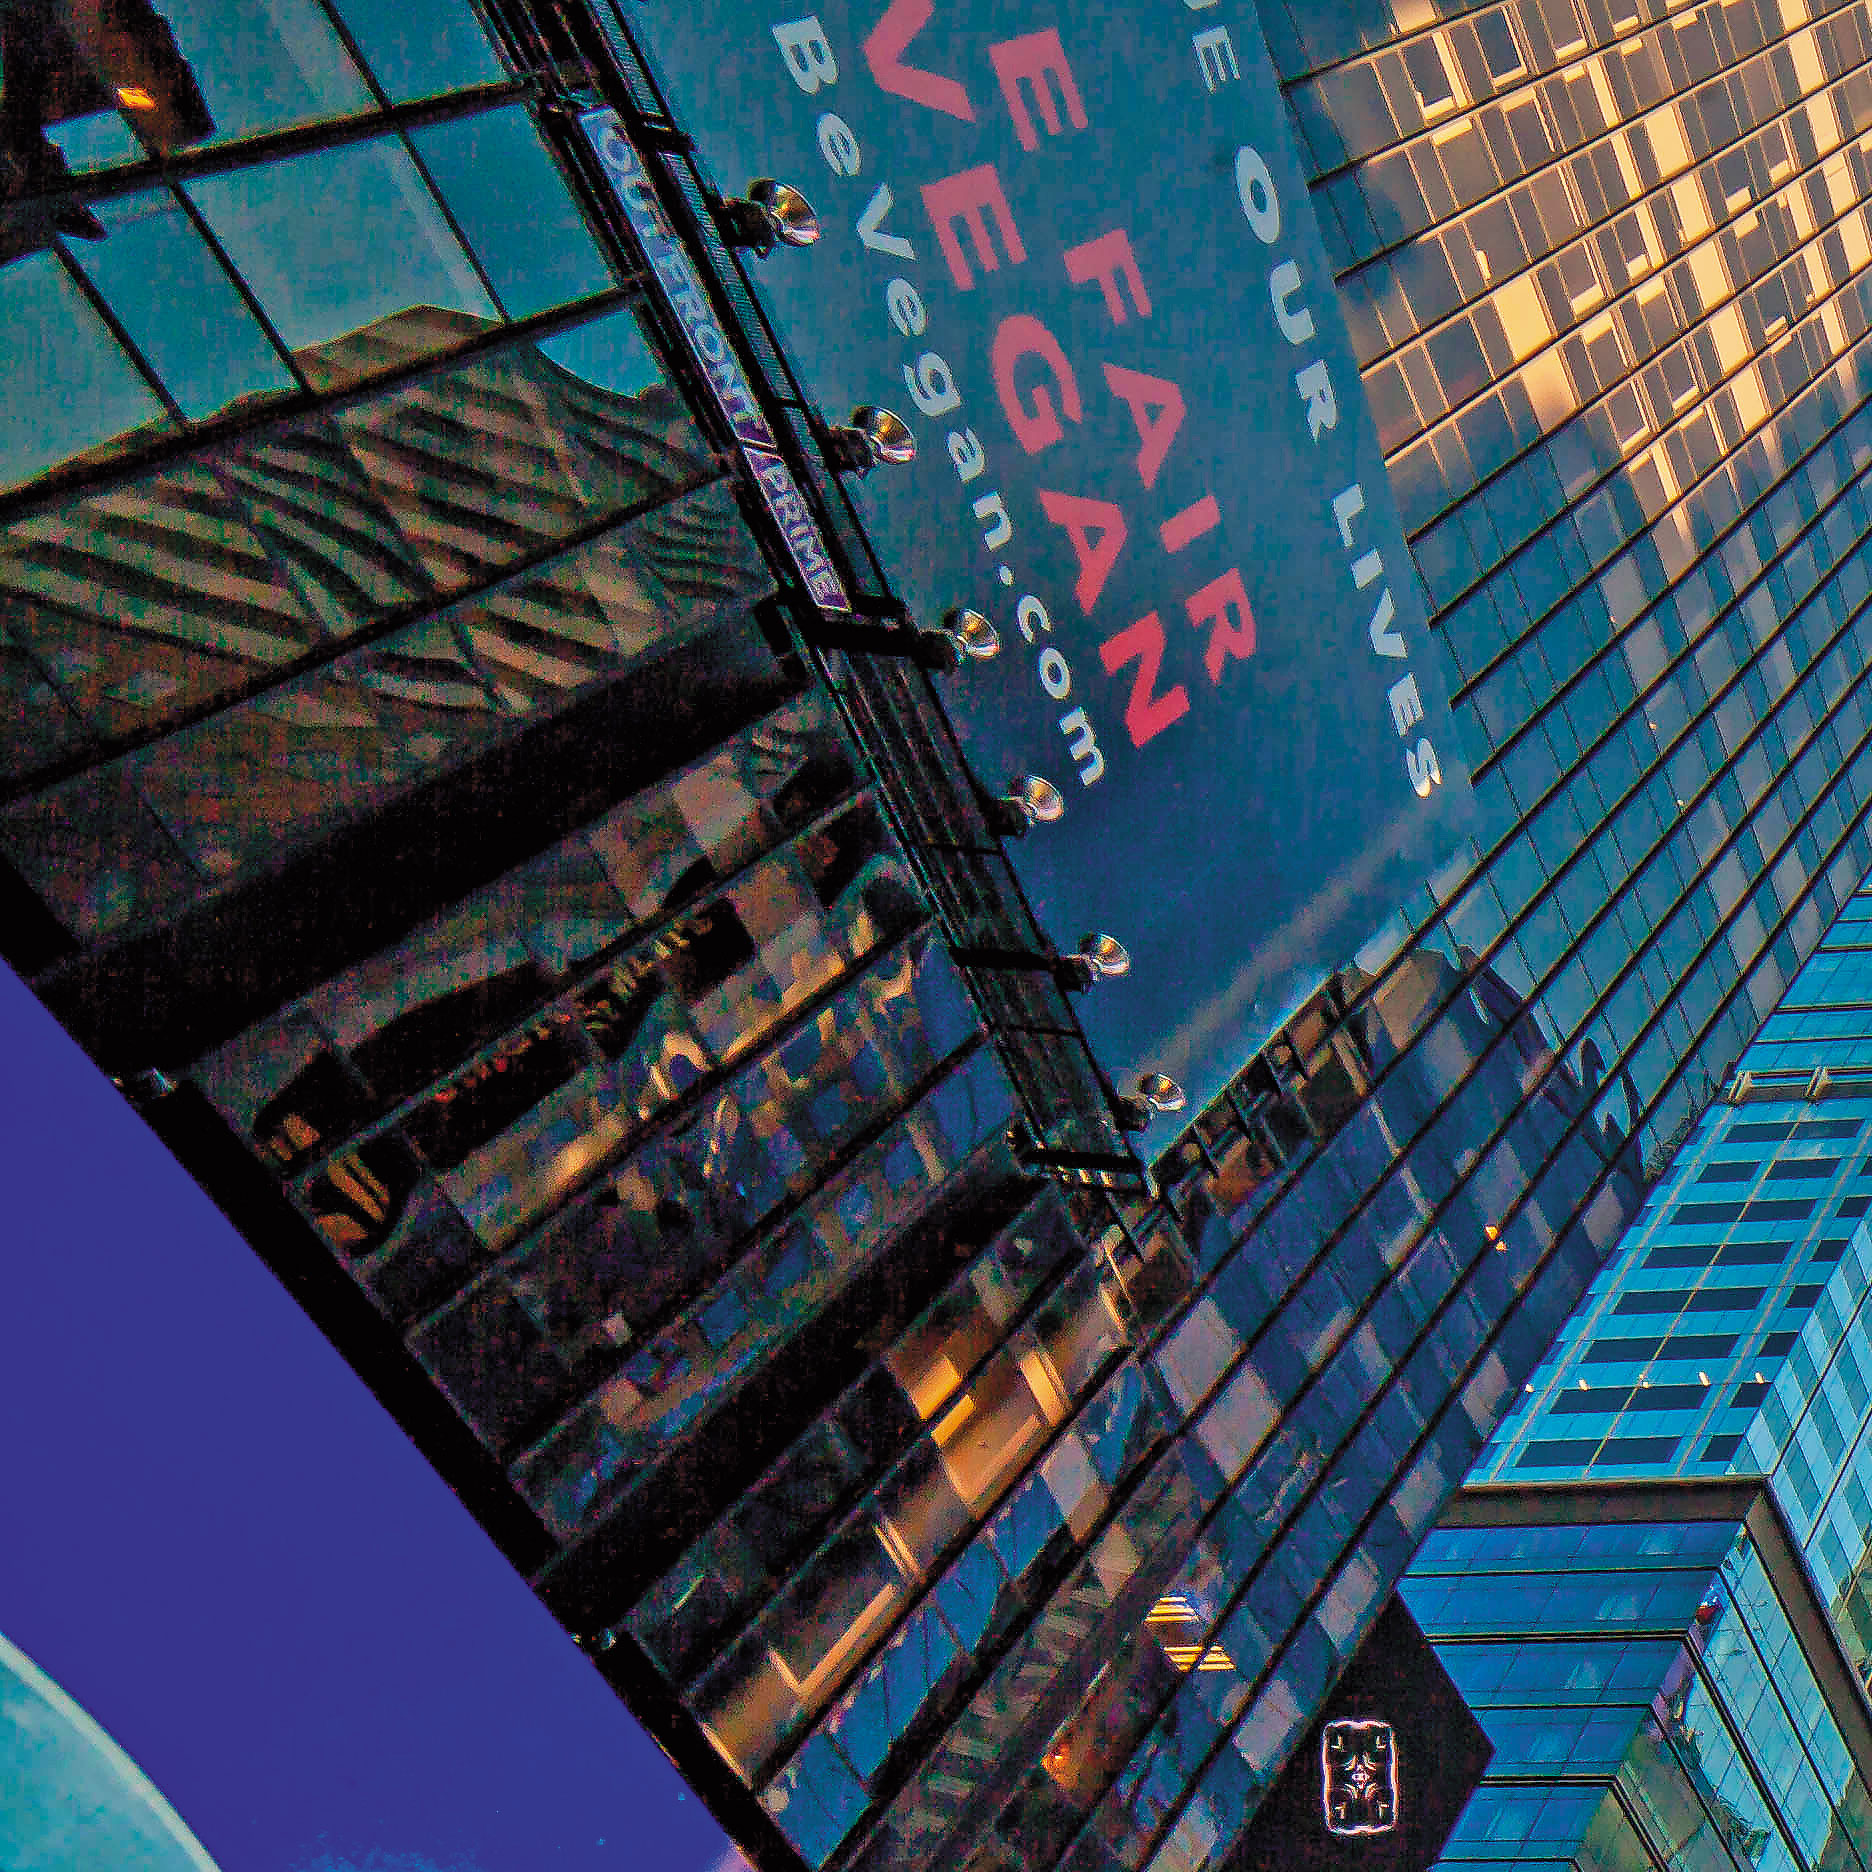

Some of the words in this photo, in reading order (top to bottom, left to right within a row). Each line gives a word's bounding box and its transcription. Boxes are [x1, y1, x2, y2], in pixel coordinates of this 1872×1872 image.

[762, 462, 847, 600] PRIME
[862, 0, 1191, 750] VEGAN
[1062, 228, 1257, 686] FAIR
[1235, 144, 1338, 444] OUR
[1331, 483, 1442, 798] LIVES
